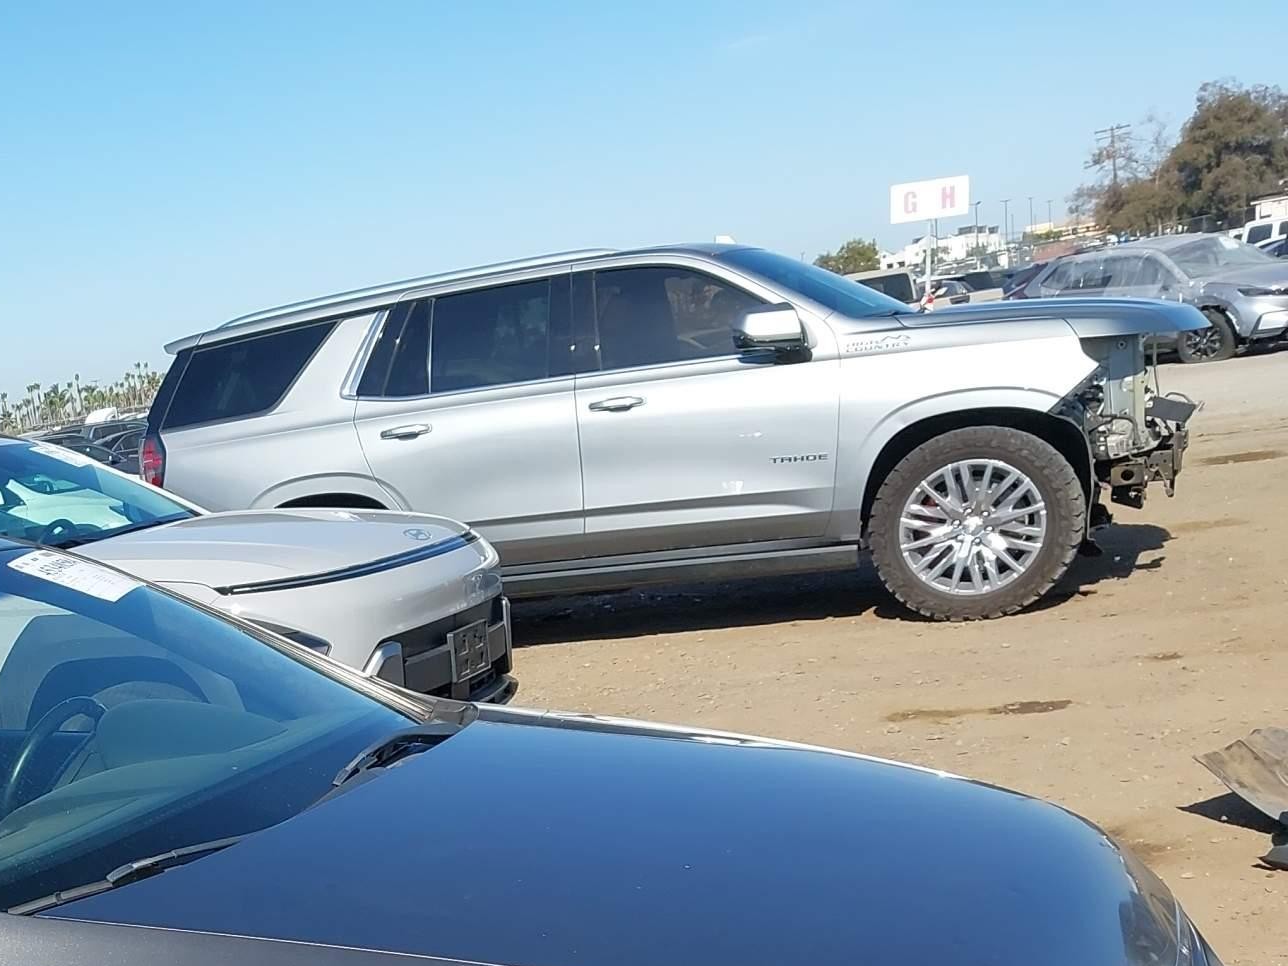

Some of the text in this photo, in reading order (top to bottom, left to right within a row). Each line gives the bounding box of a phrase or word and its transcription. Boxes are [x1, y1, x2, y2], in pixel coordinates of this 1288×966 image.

[903, 184, 956, 214] G H
[769, 453, 829, 464] TAHOE
